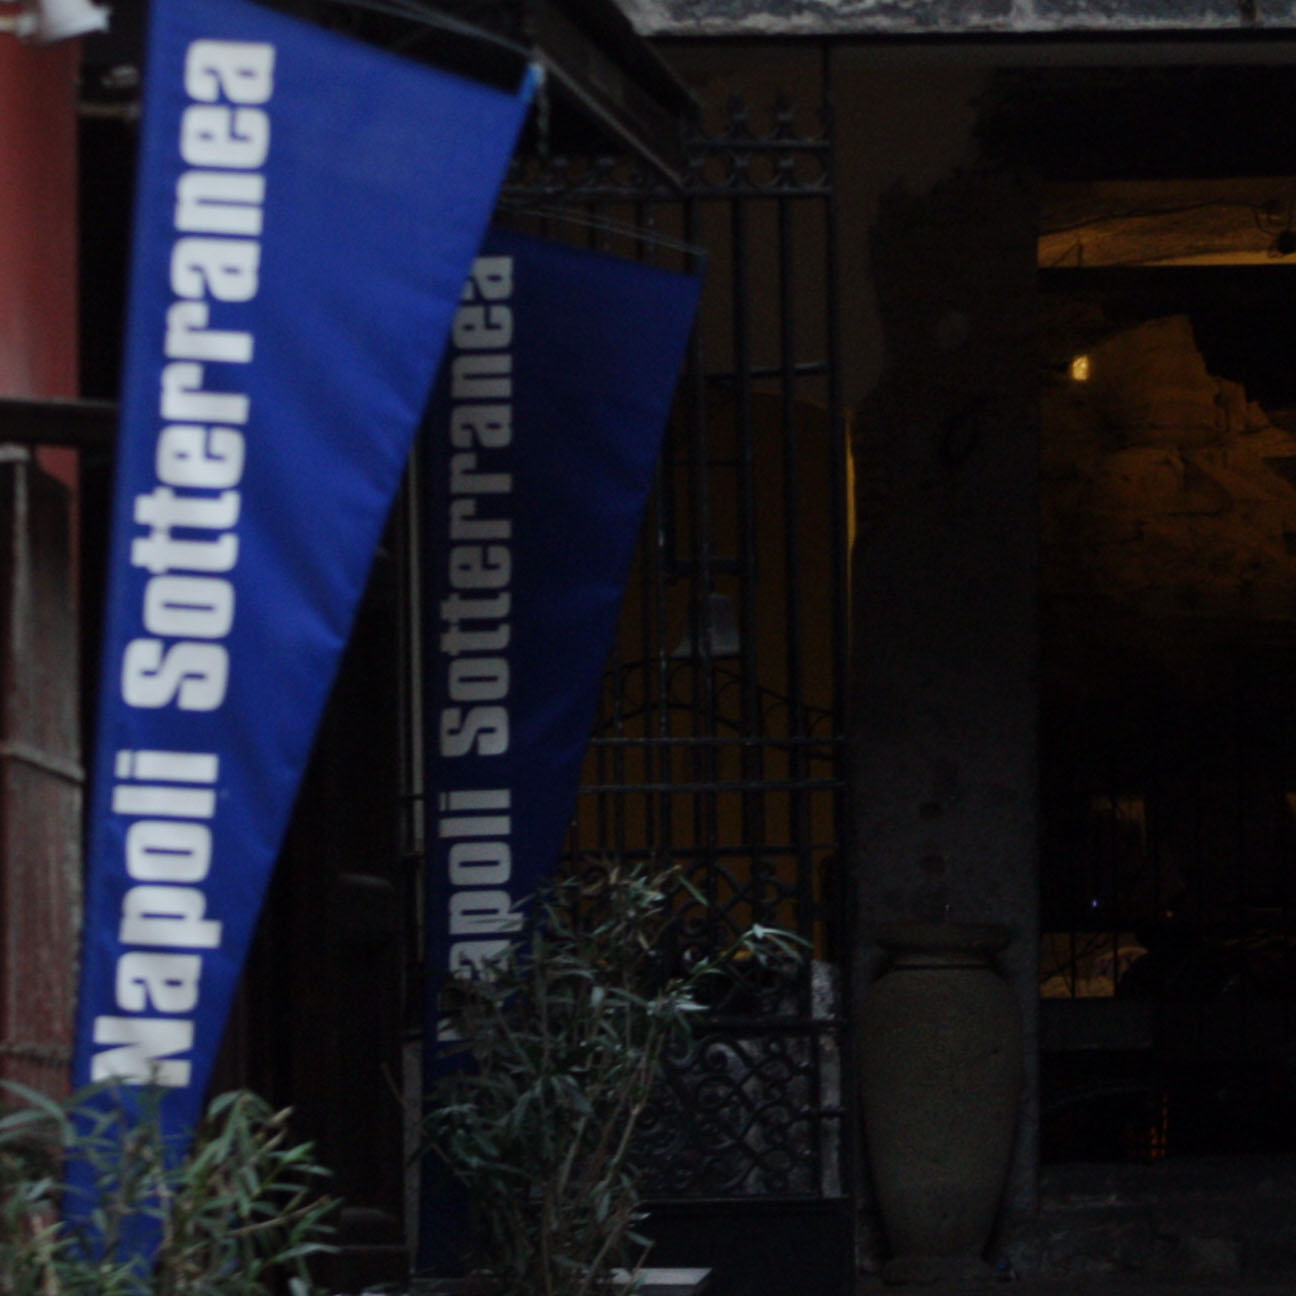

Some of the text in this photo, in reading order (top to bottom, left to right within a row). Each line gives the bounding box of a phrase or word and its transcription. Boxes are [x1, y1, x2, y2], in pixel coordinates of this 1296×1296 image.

[90, 39, 276, 1088] Napoli Sotterranea
[437, 255, 524, 1042] apoli Sotterranea
